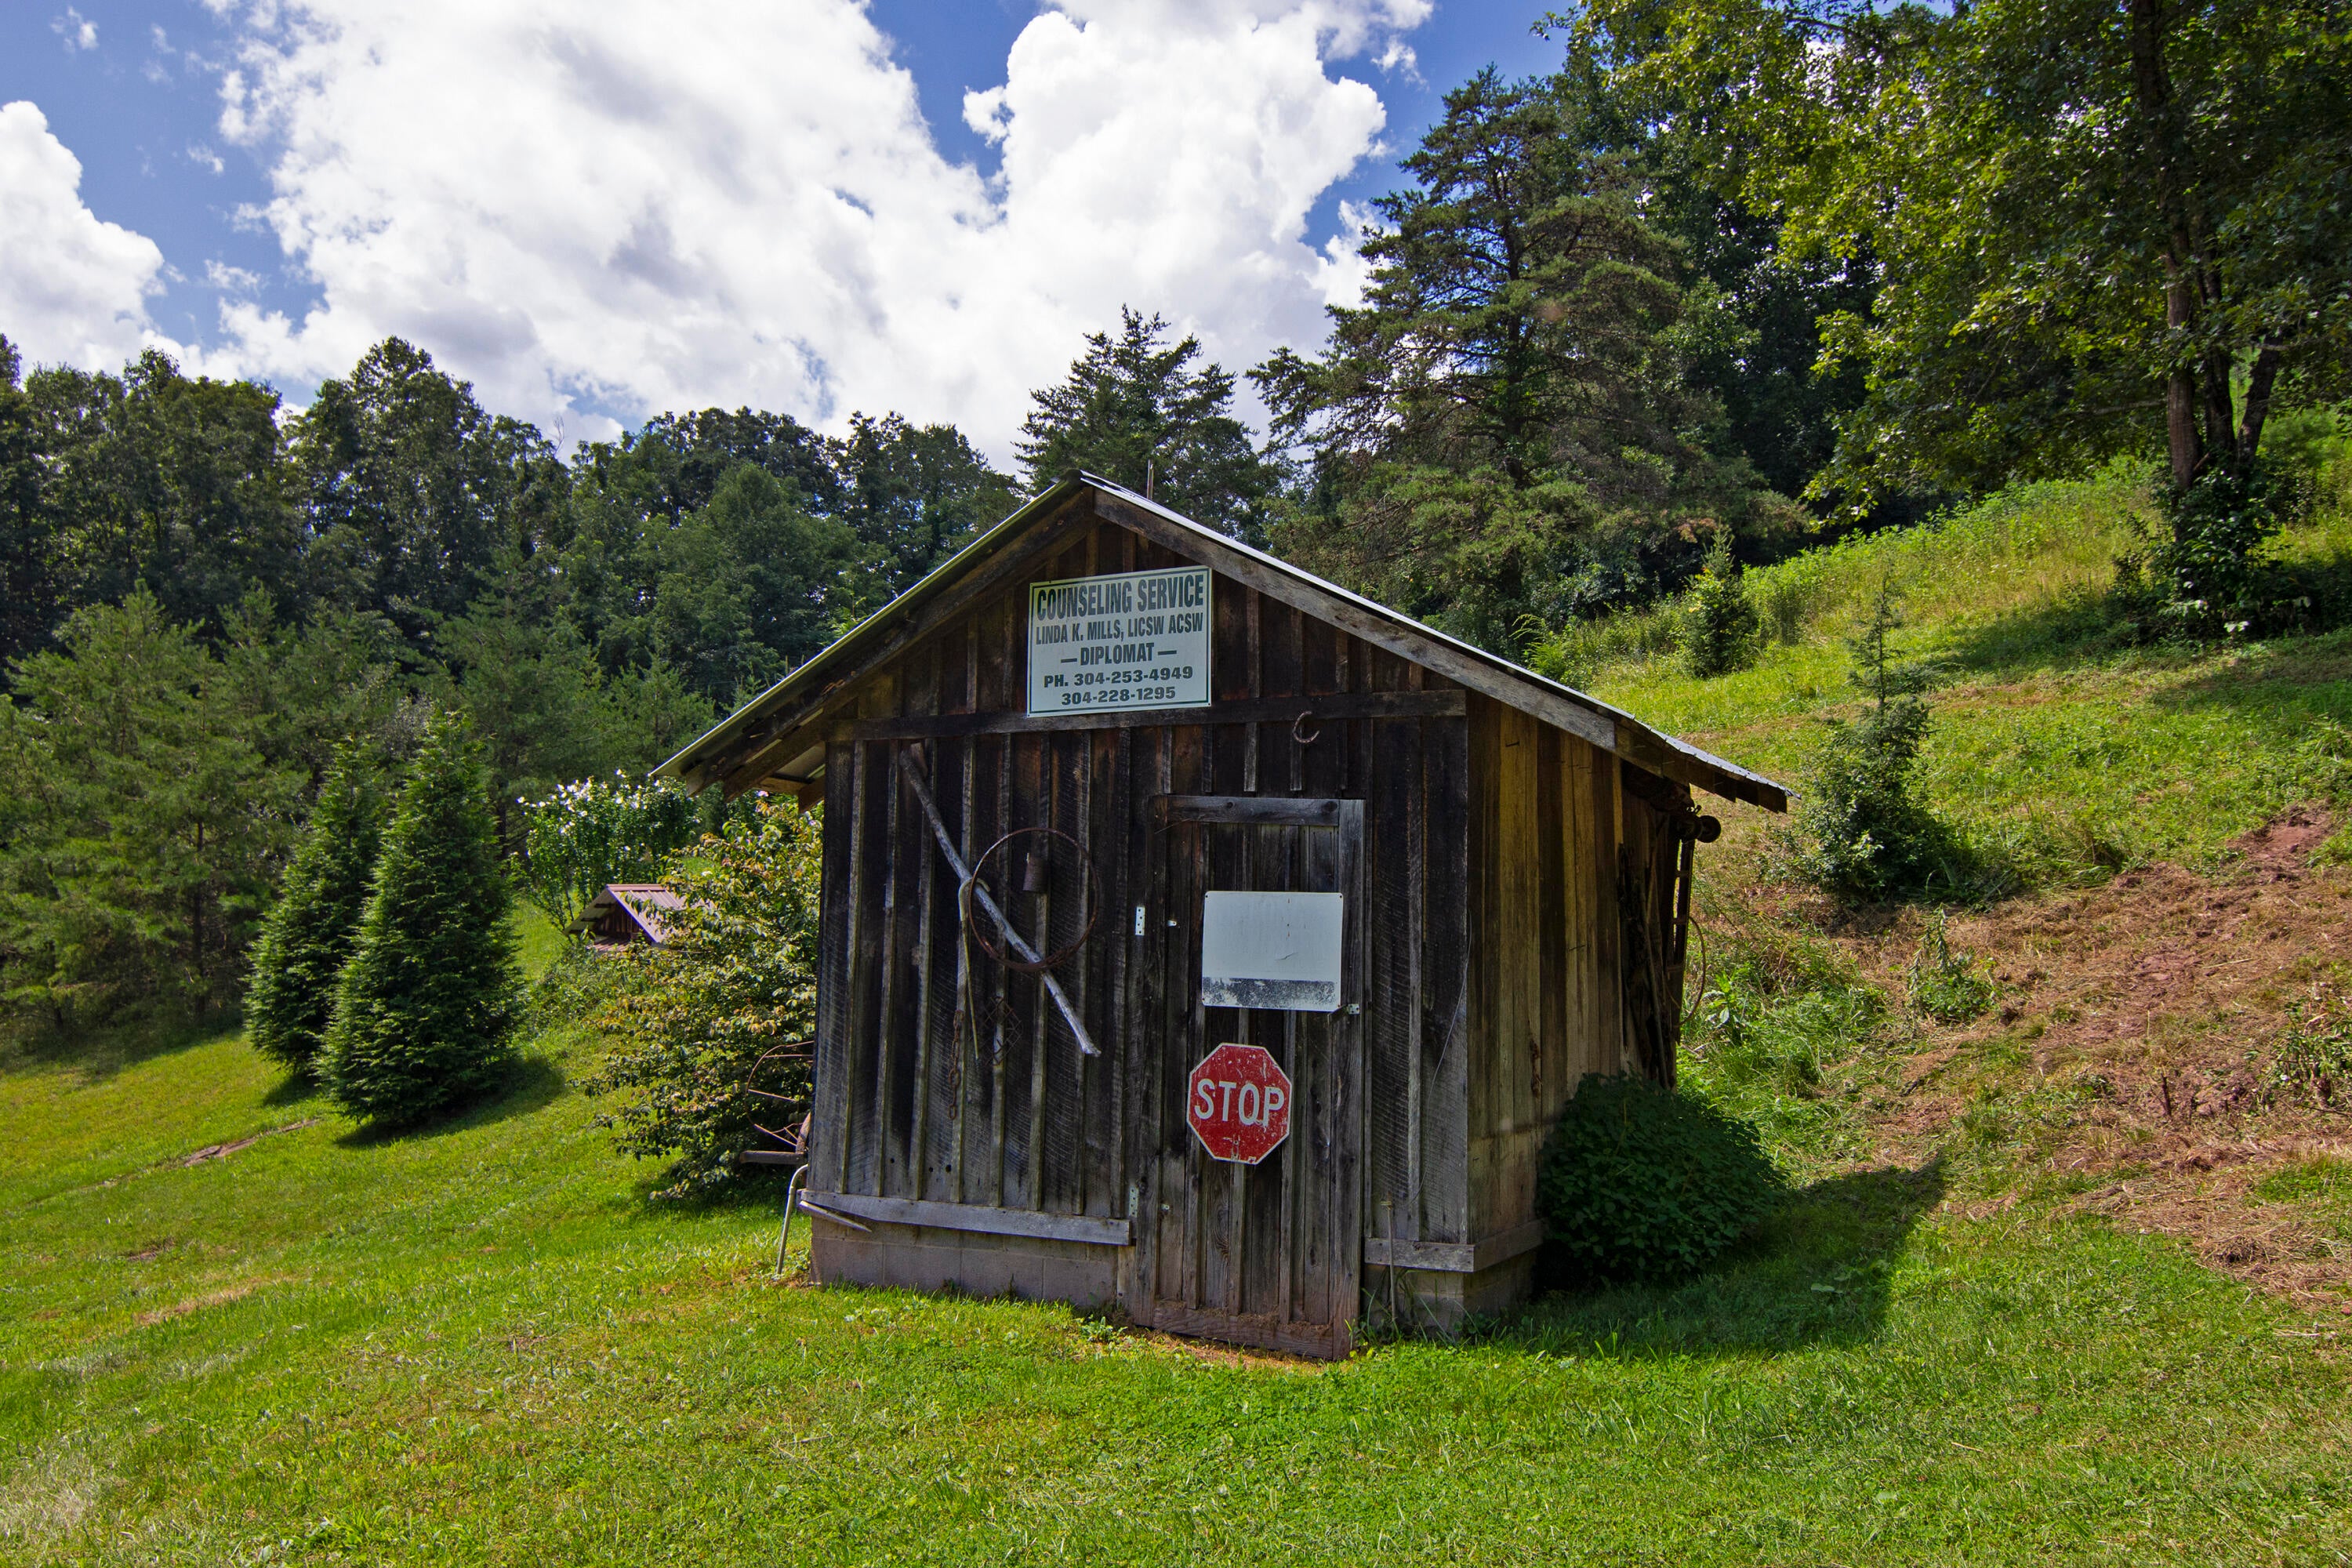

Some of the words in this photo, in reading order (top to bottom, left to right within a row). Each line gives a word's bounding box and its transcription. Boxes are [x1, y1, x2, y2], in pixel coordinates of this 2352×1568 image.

[1037, 581, 1132, 621] COUNSELING
[1138, 575, 1204, 612] SERVICE
[1036, 623, 1068, 644] LINDA
[1072, 622, 1083, 641] K.
[1087, 619, 1123, 641] MILLS,
[1128, 615, 1164, 637] LICSW
[1168, 612, 1203, 634] ACSW
[1080, 642, 1154, 666] DIPLOMAT
[1044, 675, 1069, 688] PH.
[1074, 666, 1193, 687] 304-253-4949
[1061, 686, 1176, 706] 304-228-1295
[1194, 1078, 1285, 1127] STOP
